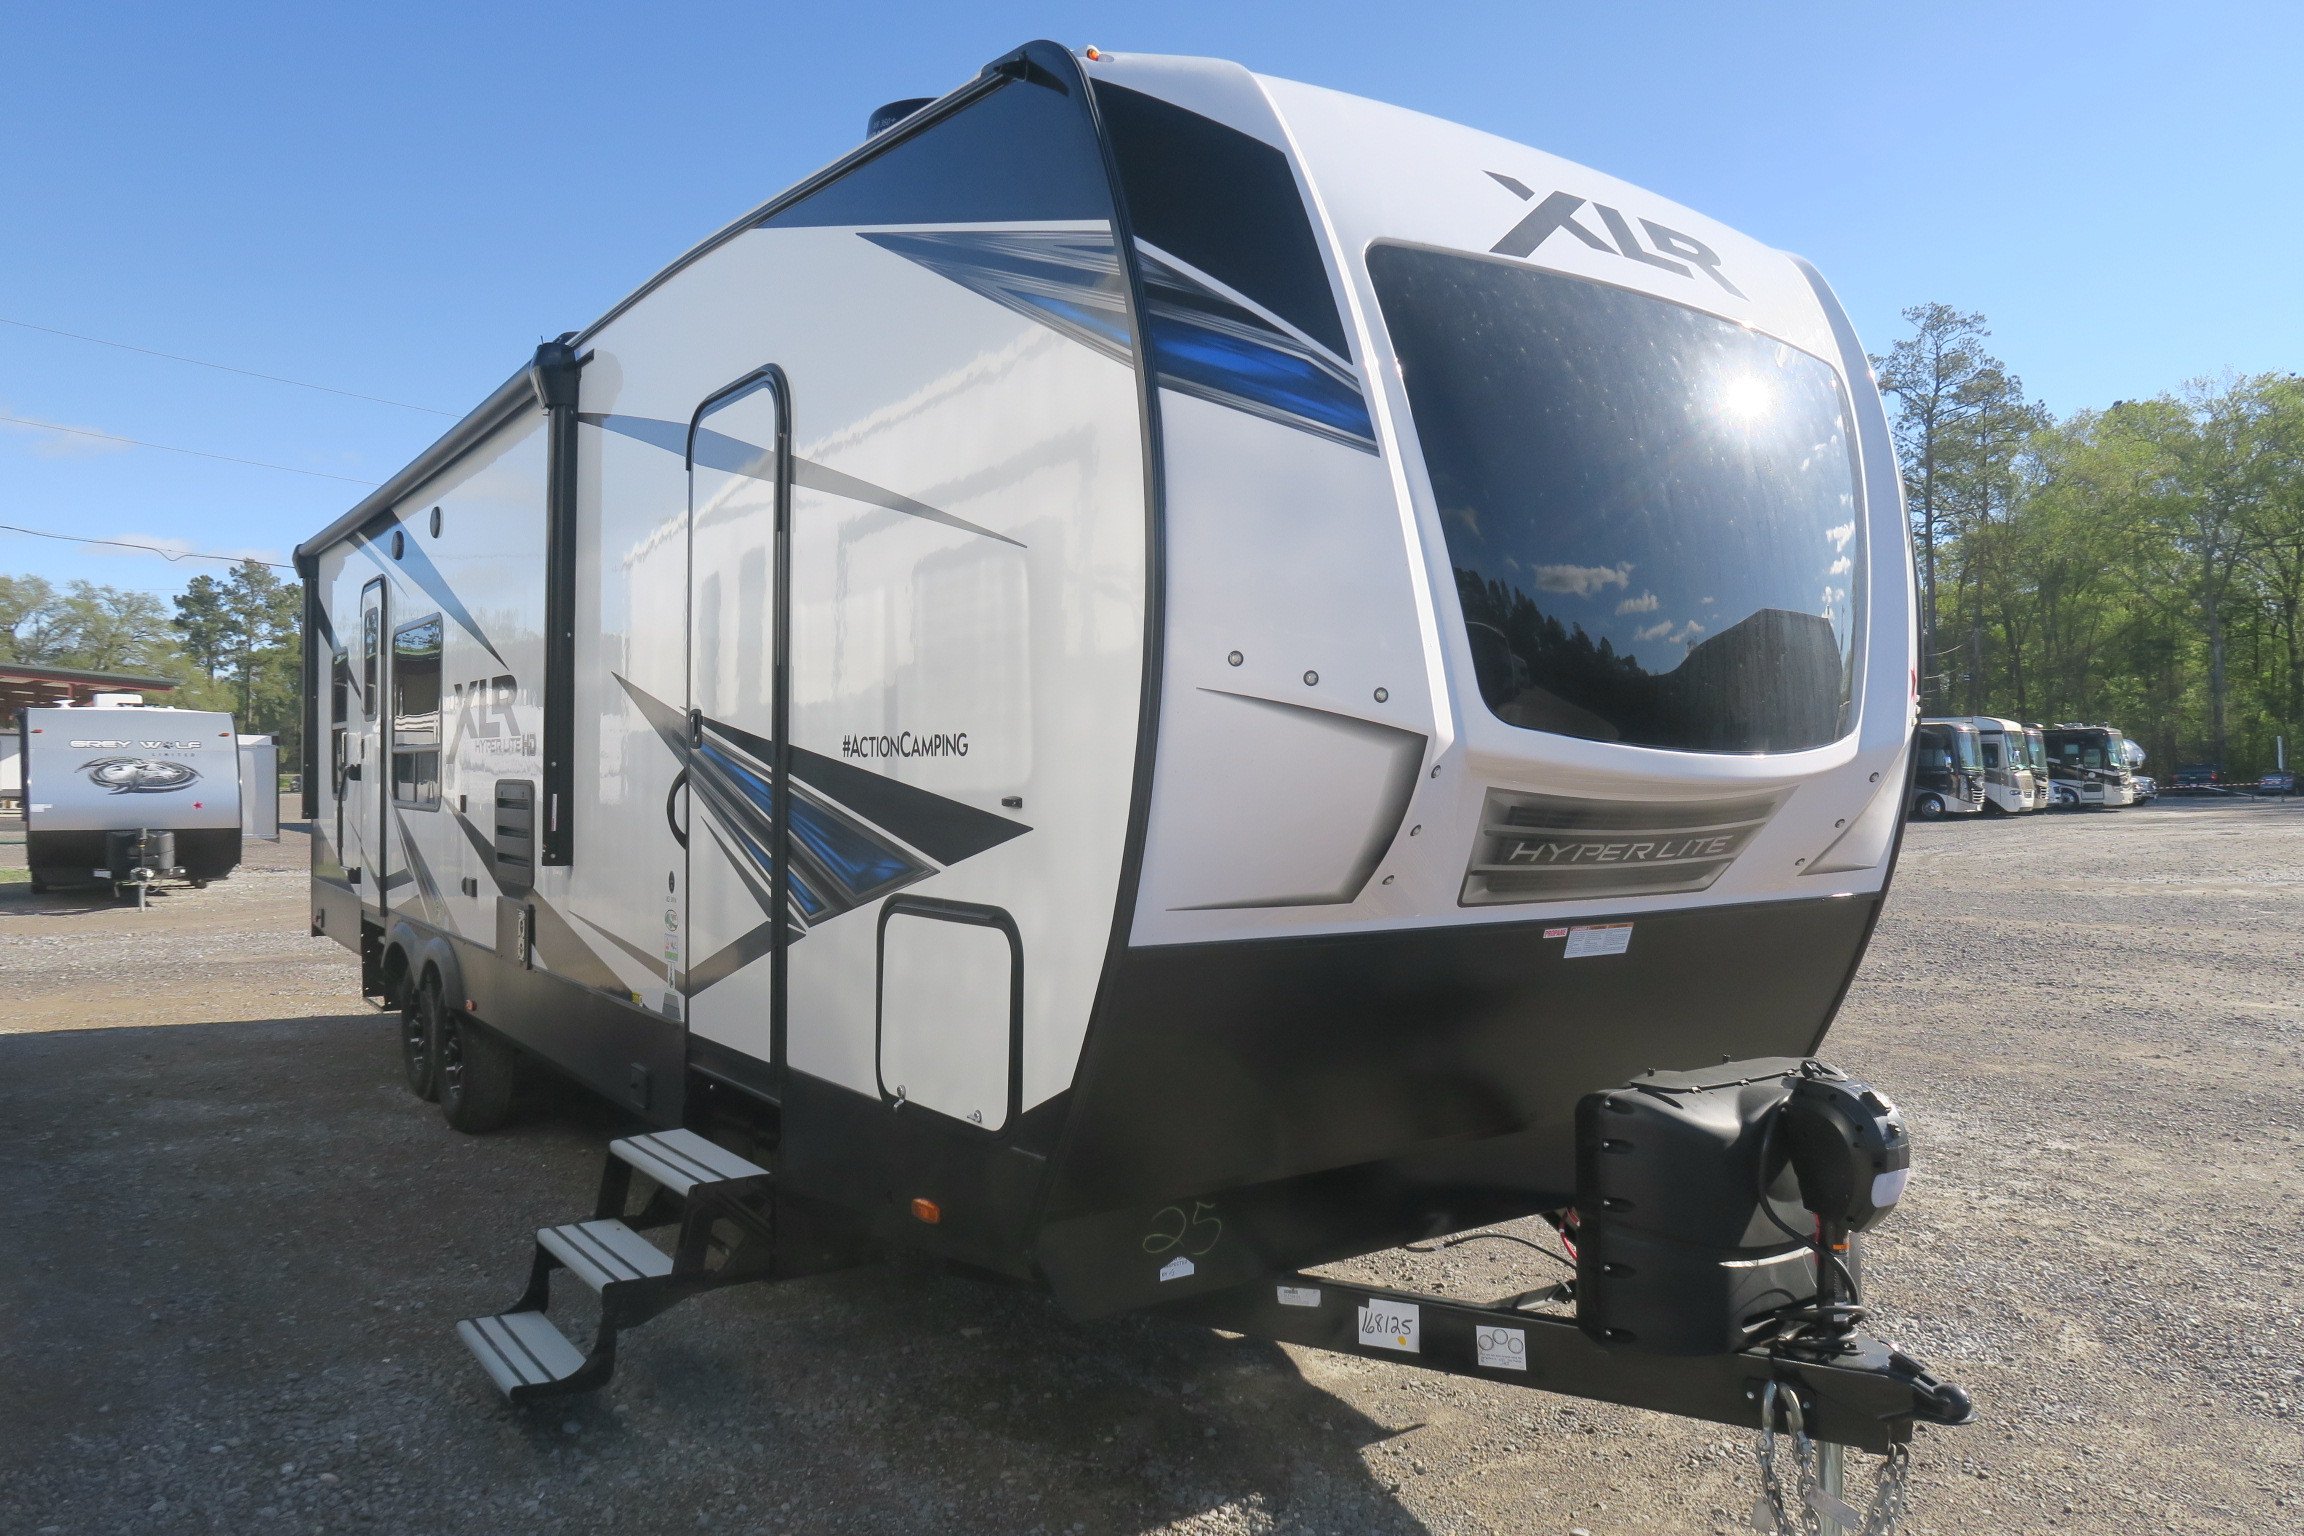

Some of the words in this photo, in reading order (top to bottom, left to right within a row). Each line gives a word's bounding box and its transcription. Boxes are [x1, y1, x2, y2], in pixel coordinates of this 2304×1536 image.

[1482, 169, 1750, 302] XLR
[70, 740, 131, 748] GREY
[446, 674, 520, 764] XLR
[1143, 1200, 1222, 1255] 25
[1362, 1310, 1413, 1335] 168125
